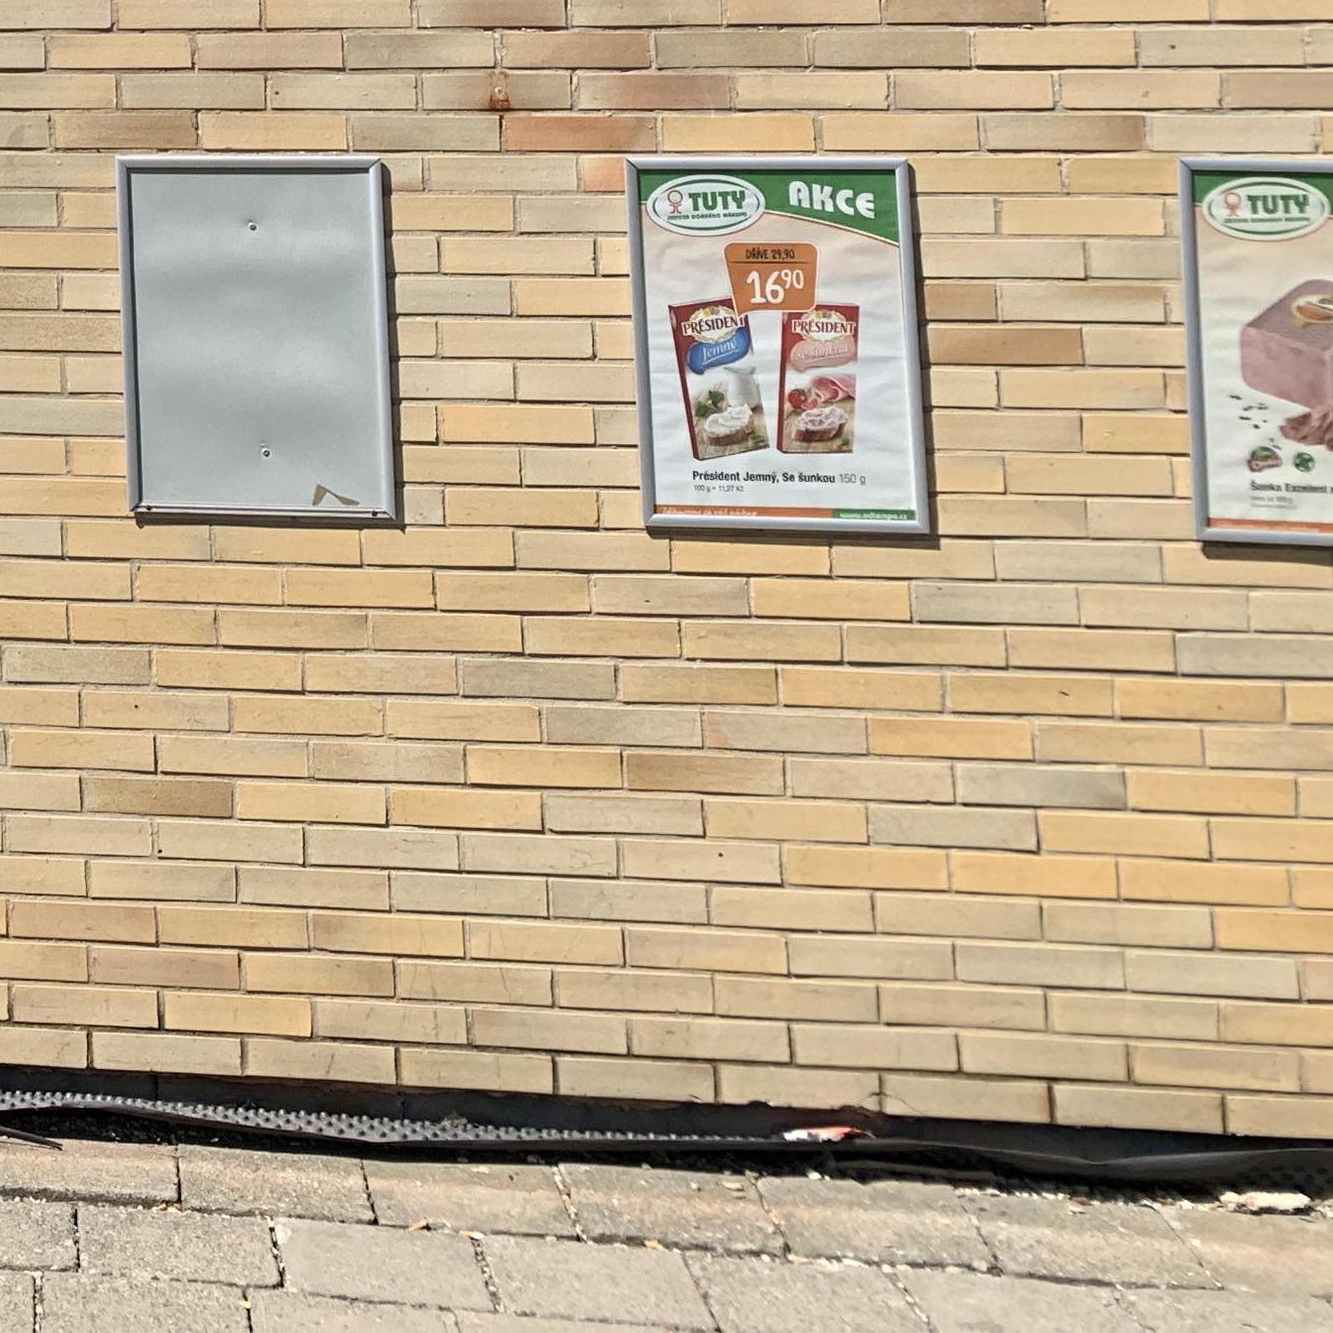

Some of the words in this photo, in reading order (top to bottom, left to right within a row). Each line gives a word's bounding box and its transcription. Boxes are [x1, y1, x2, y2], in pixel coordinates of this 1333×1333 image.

[688, 190, 746, 211] TUTY
[789, 180, 875, 219] AKCE
[1246, 194, 1309, 215] TUTY
[745, 247, 769, 260] DŘÍVE
[771, 249, 796, 261] 29,90
[683, 314, 745, 335] PRÉSIDENT
[793, 319, 856, 335] PRÉSIDENT
[692, 470, 740, 482] Président
[743, 471, 779, 484] Jemný,
[783, 472, 796, 483] Se
[798, 472, 836, 483] šunkou
[839, 473, 857, 484] 150
[859, 475, 867, 486] g
